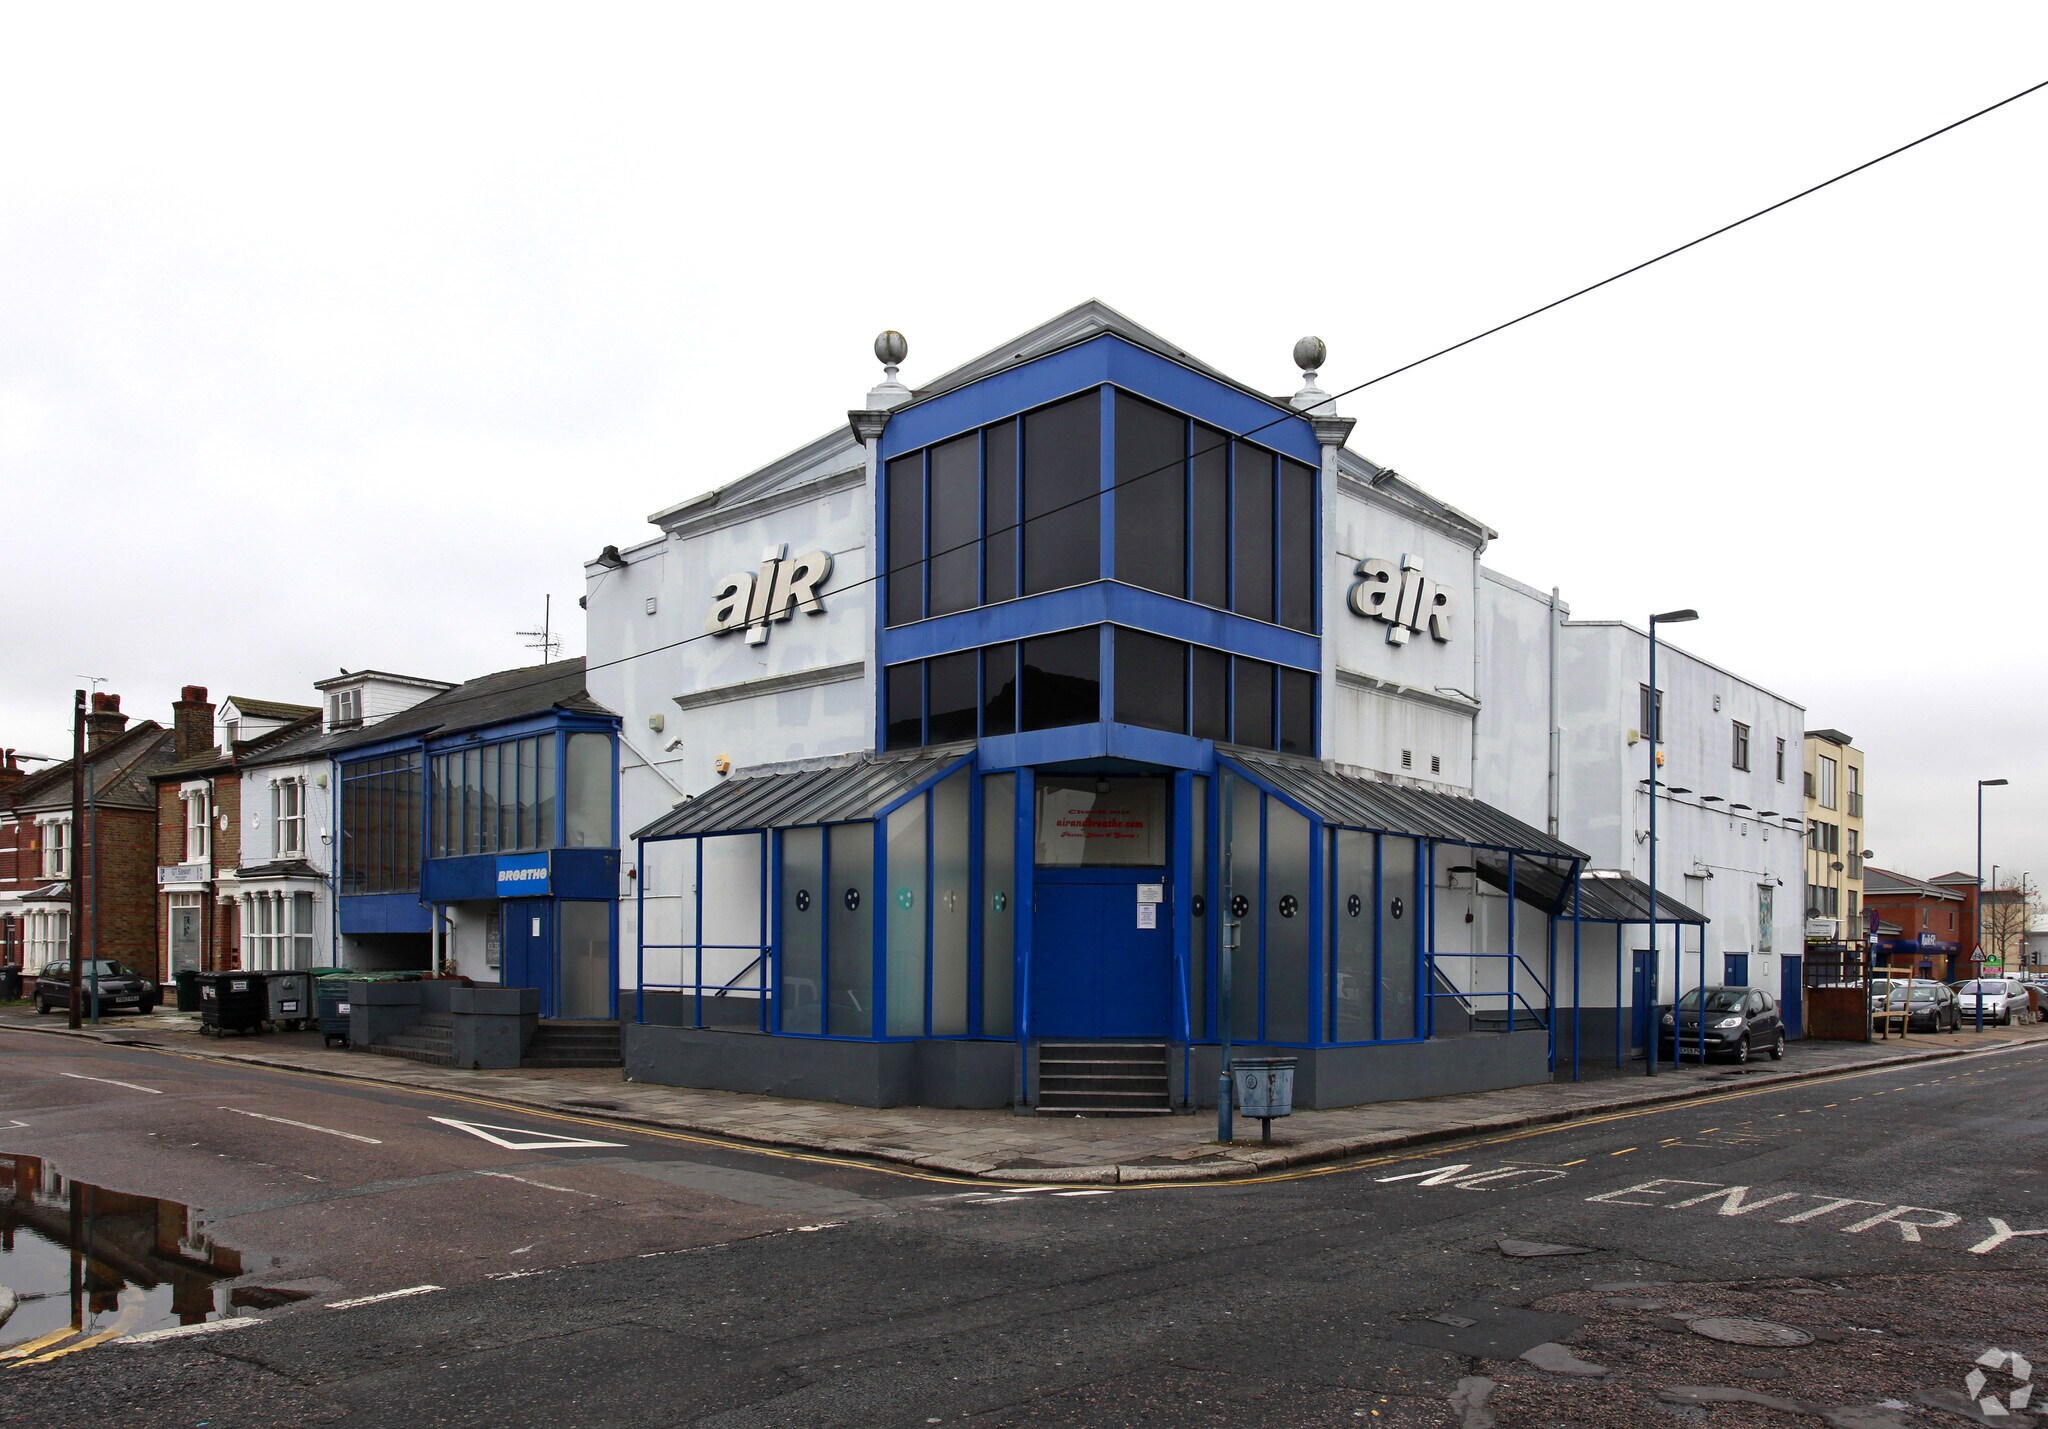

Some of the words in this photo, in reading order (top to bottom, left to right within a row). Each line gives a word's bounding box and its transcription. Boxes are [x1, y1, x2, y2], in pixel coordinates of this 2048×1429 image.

[1056, 818, 1145, 829] airandbreathe.com
[1374, 1163, 1568, 1192] NO
[1584, 1178, 2048, 1254] ENTRY
